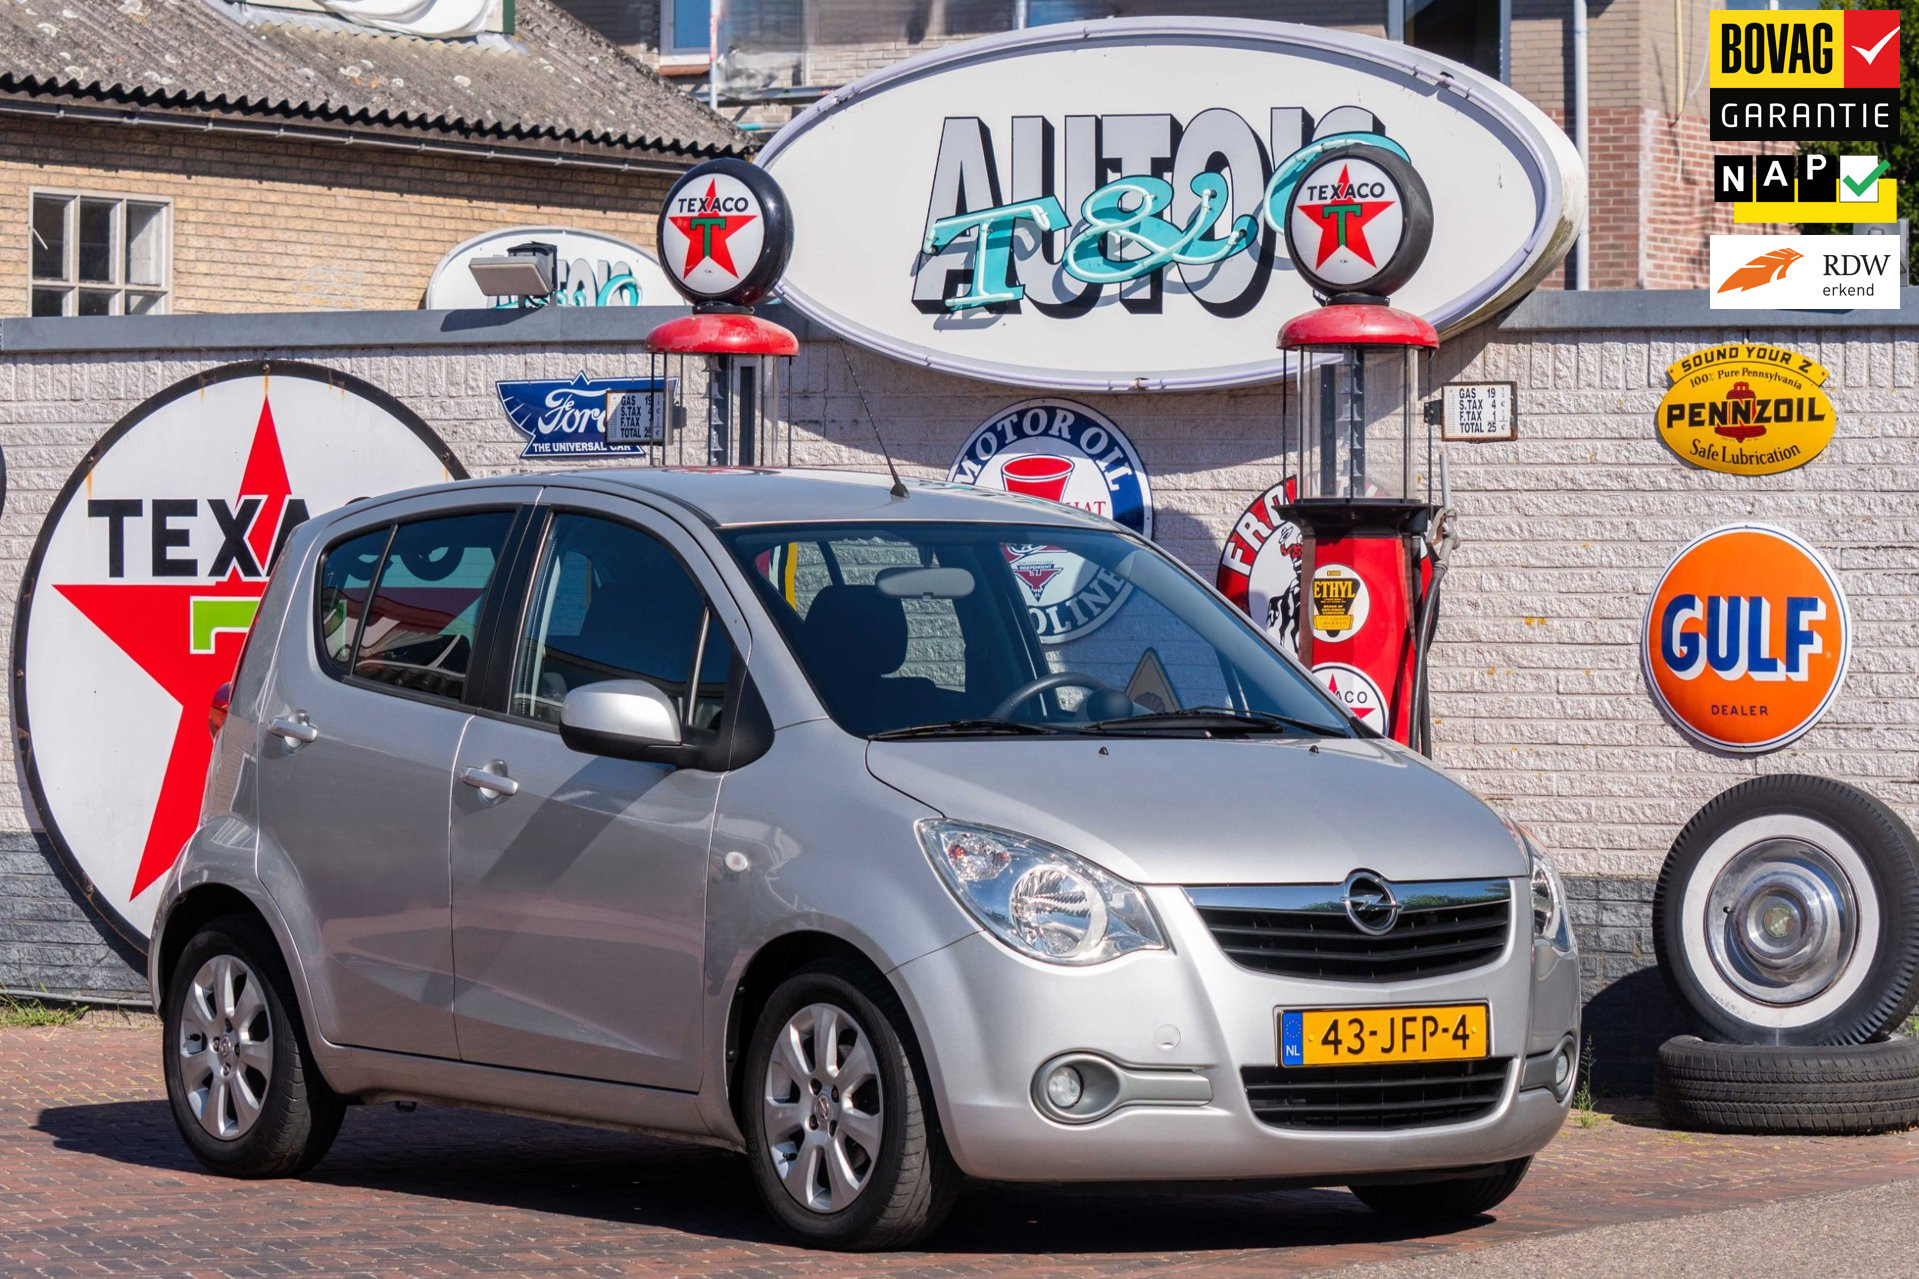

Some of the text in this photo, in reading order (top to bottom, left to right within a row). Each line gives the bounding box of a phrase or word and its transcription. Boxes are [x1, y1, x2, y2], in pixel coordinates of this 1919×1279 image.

[1307, 183, 1386, 201] TEXACO
[678, 197, 749, 213] TEXACO
[1681, 347, 1813, 373] SOUND YOUR Z
[1690, 367, 1802, 390] 100% Pure Pennsylvania
[1459, 388, 1476, 399] GAS
[1487, 387, 1496, 399] 19
[620, 396, 636, 406] GAS
[1459, 399, 1483, 410] S.TAX
[1491, 400, 1496, 410] 4
[537, 388, 606, 435] For
[620, 406, 641, 417] S.TAX
[1459, 411, 1482, 422] F.TAX
[1492, 411, 1496, 421] 1
[1667, 397, 1826, 429] PENNZOIL
[620, 417, 640, 427] F.TAX
[1459, 422, 1484, 433] TOTAL
[1487, 422, 1497, 433] 25
[620, 427, 641, 438] TOTAL
[533, 443, 551, 452] THE
[554, 442, 607, 452] UNIVERSAL
[954, 408, 1133, 491] MOTOR OIL
[1689, 438, 1801, 466] Safe Lubrication
[1313, 581, 1356, 598] ETHYL
[1661, 594, 1826, 681] GULF
[1711, 704, 1769, 716] DEALER
[1321, 1014, 1470, 1056] 43-JFP-4
[1286, 1045, 1301, 1056] NL
